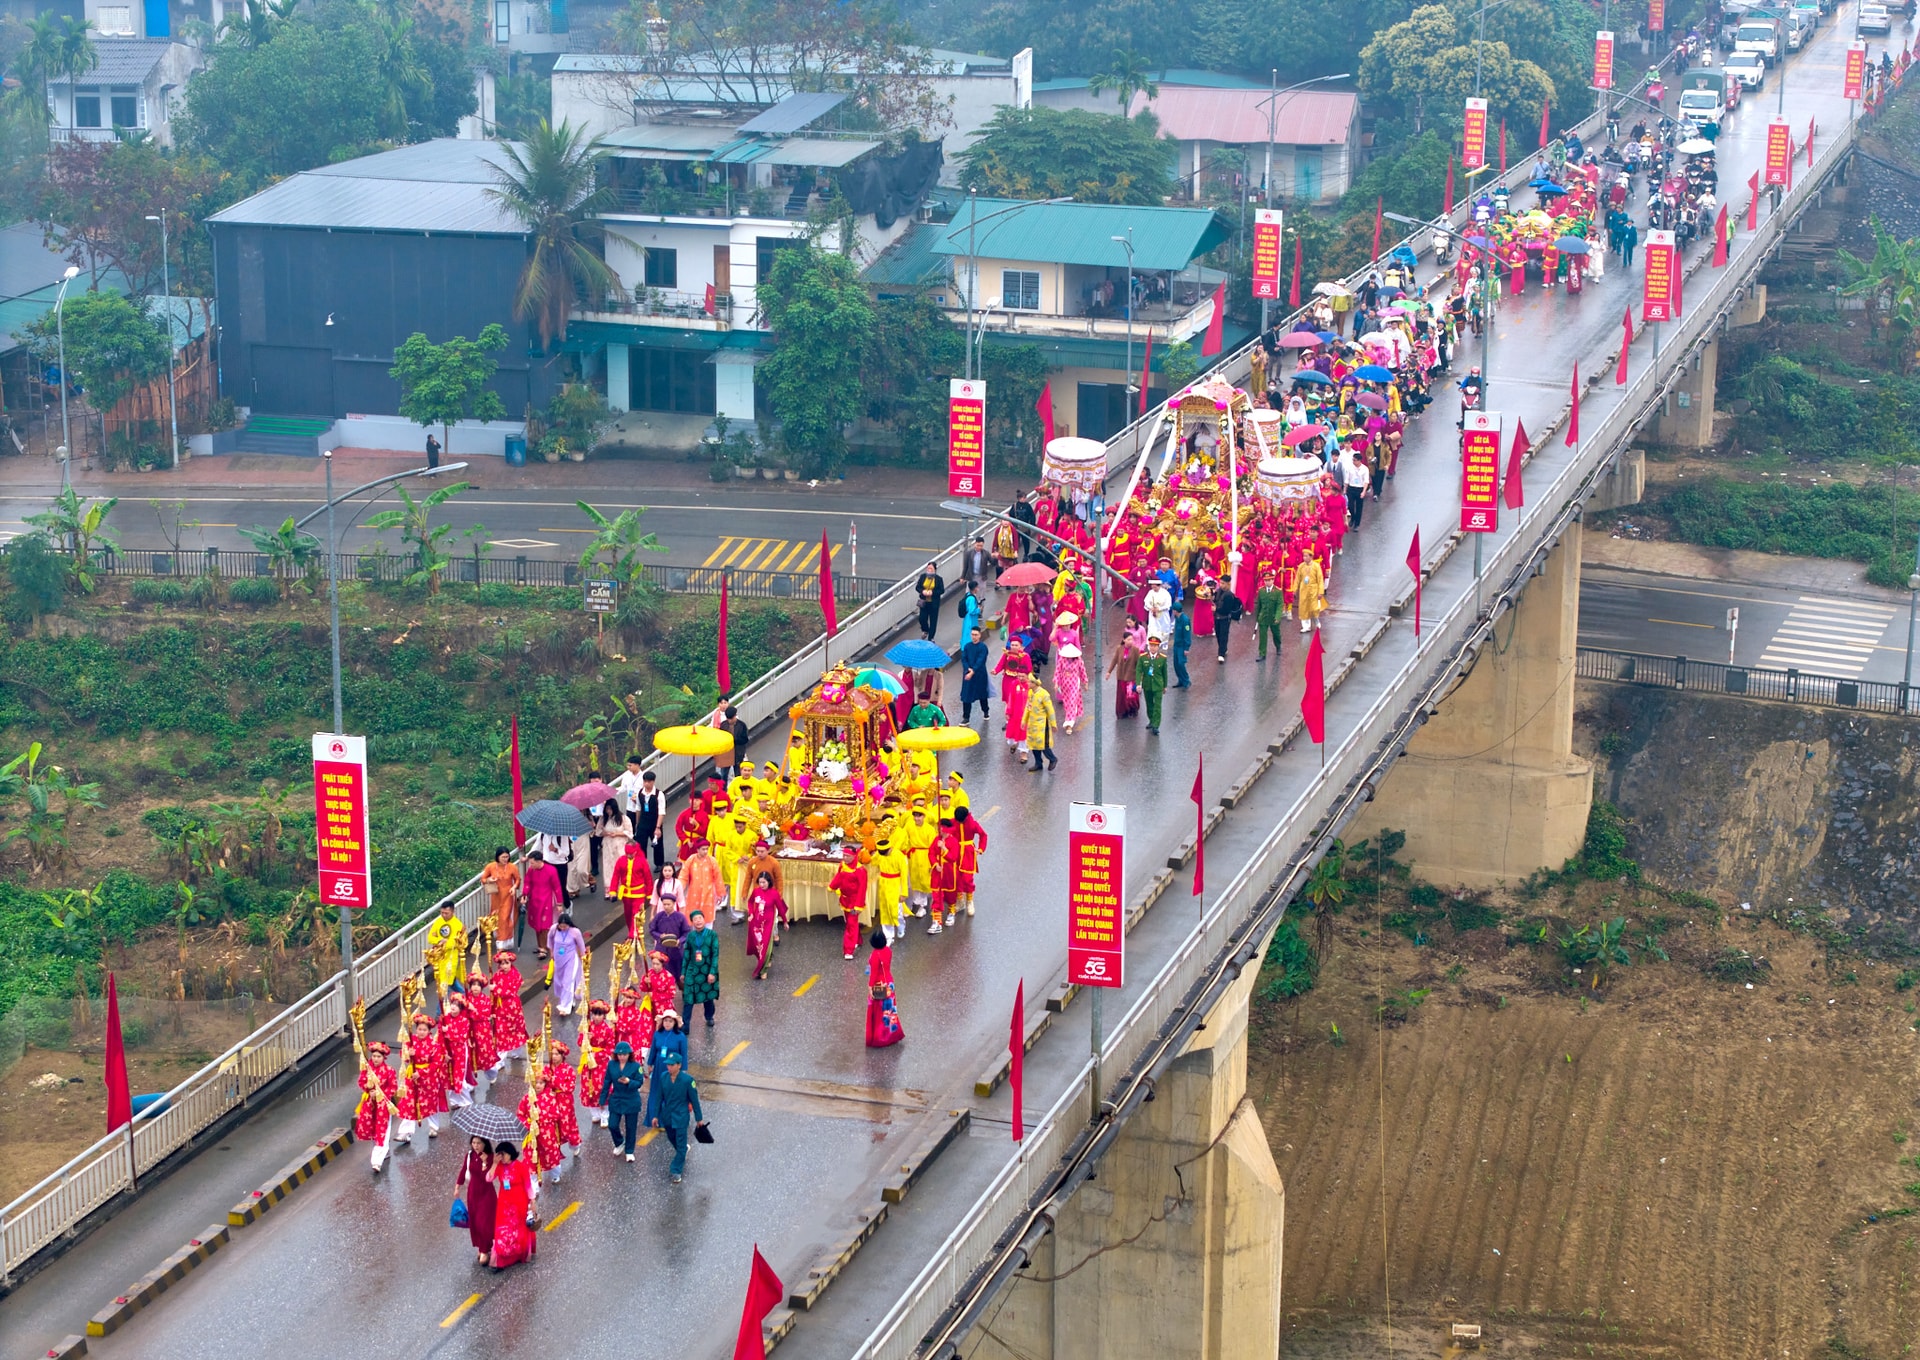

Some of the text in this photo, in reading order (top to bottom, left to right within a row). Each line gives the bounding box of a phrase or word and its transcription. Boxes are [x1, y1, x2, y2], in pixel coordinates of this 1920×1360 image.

[1472, 515, 1486, 525] 5G
[591, 587, 610, 597] CẤM
[322, 773, 353, 784] PHÁT TRIỂN
[326, 786, 350, 797] VĂN HÓA
[325, 800, 353, 811] THỰC HIỆN
[327, 812, 351, 823] DÂN CHỦ
[330, 825, 350, 837] TIẾN BỘ
[321, 838, 360, 850] VÀ CÔNG BẰNG
[1081, 844, 1111, 855] QUYẾT TÂM
[330, 852, 339, 861] XÃ
[338, 852, 349, 863] HỘI
[1082, 857, 1110, 868] THỰC HIỆN
[1082, 869, 1109, 880] THẮNG LỢI
[334, 882, 353, 896] 5G
[1080, 882, 1110, 892] NGHỊ QUYẾT
[1073, 894, 1117, 905] ĐẠI HỘI ĐẠI BIỂU
[1076, 906, 1114, 917] ĐẢNG BỘ TỈNH
[1077, 918, 1113, 930] TUYÊN QUANG
[1076, 929, 1087, 939] LẦN
[1088, 931, 1099, 940] THỨ
[1085, 960, 1105, 976] 5G
